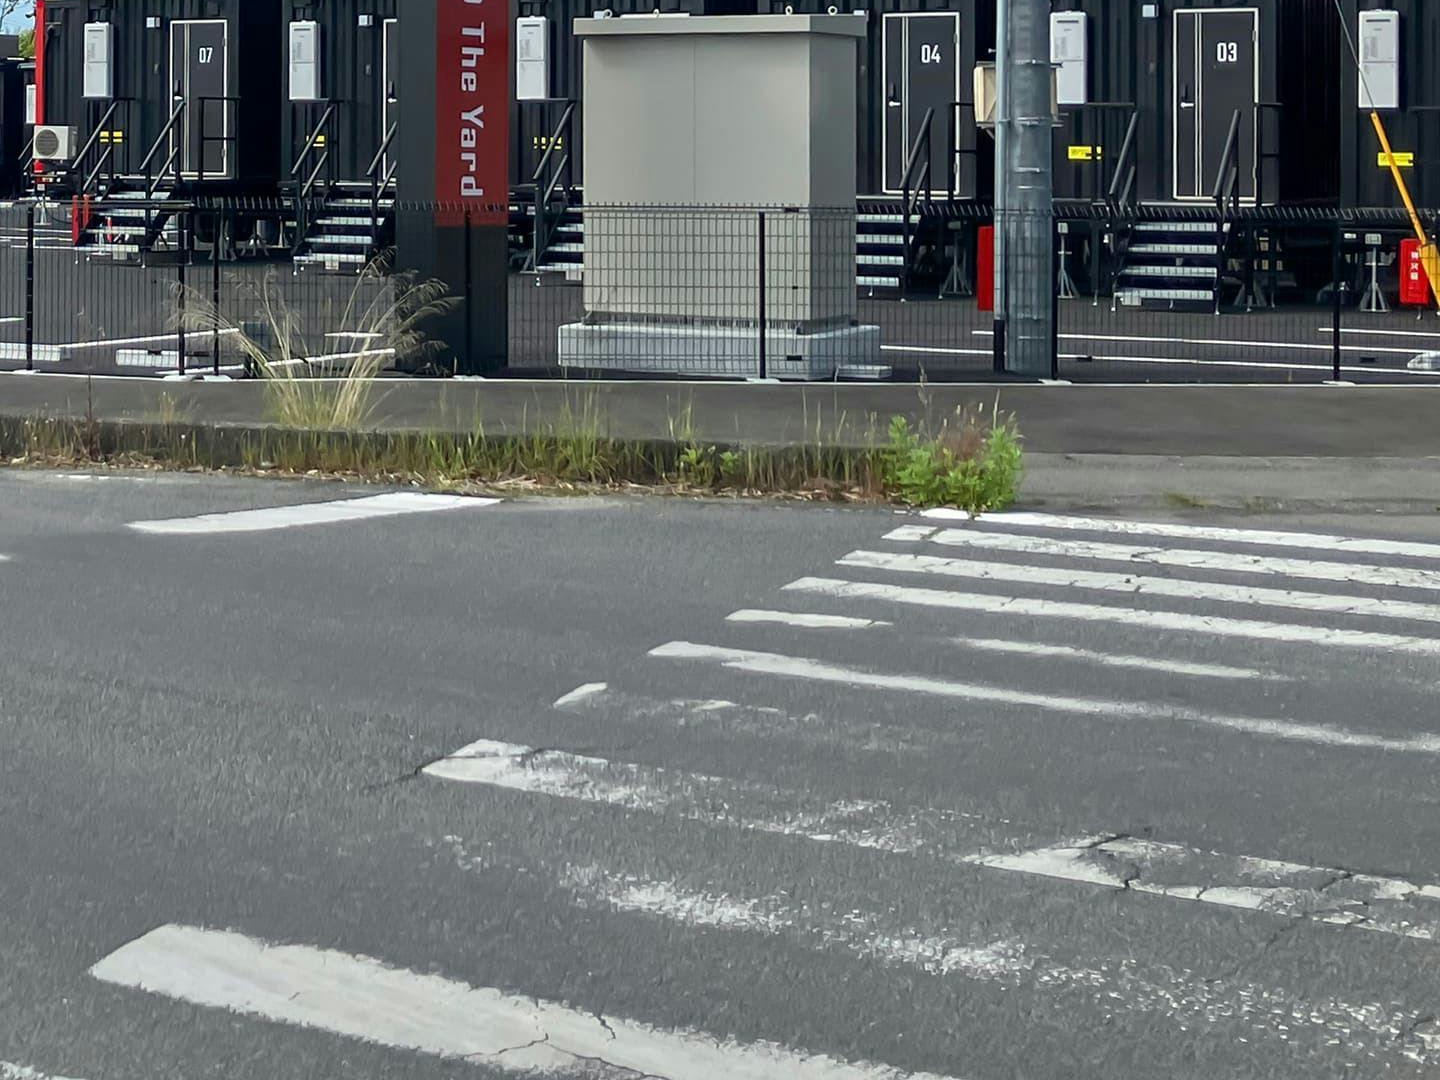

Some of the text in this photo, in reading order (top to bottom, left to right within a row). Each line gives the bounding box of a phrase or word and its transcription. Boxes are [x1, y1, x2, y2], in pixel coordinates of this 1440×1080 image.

[199, 47, 213, 63] 07
[461, 21, 485, 92] The
[921, 44, 941, 63] 04
[1217, 42, 1238, 62] 03
[461, 105, 485, 196] Yard
